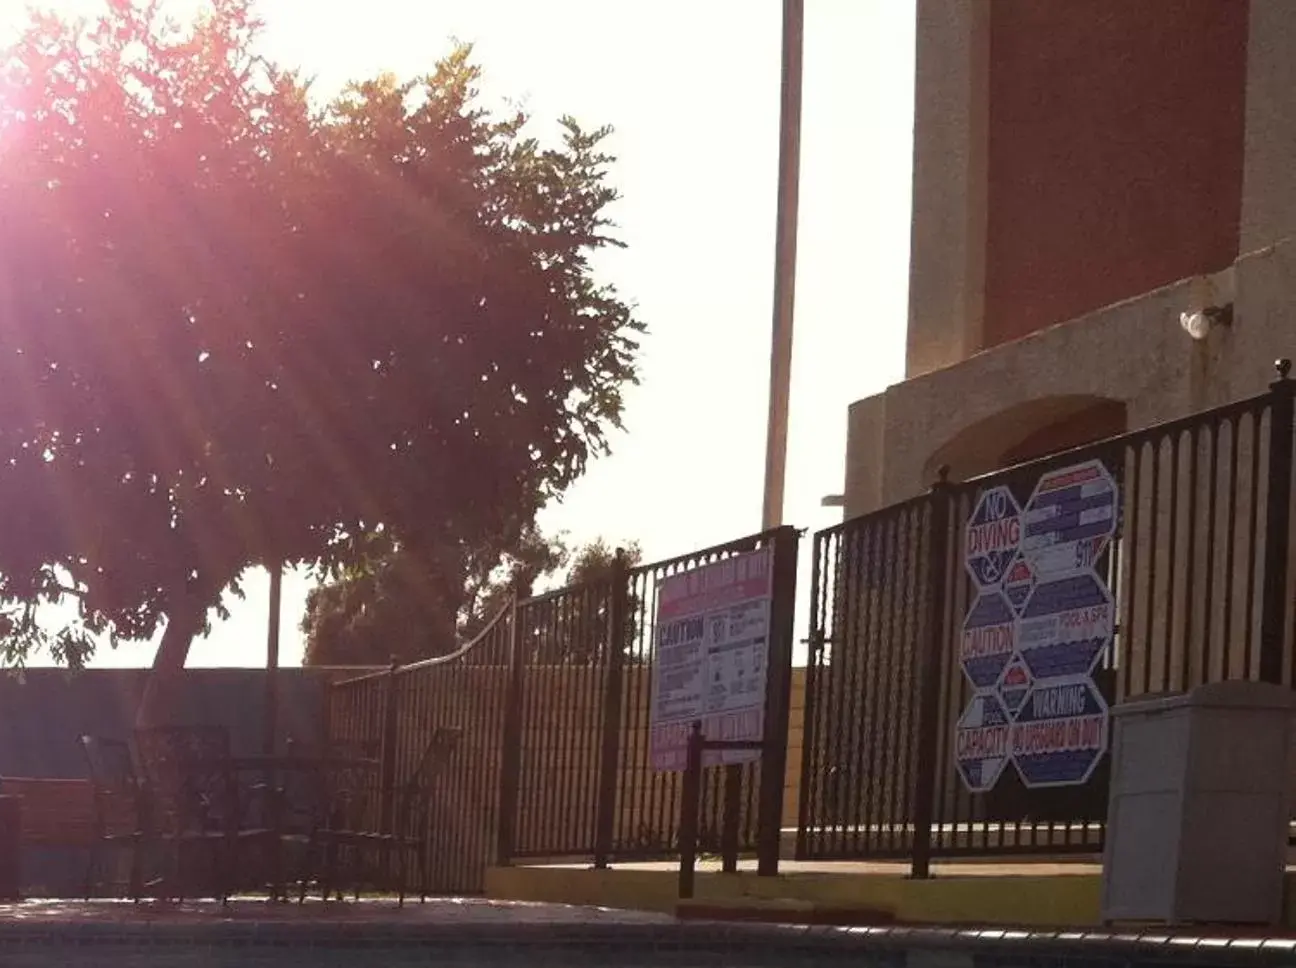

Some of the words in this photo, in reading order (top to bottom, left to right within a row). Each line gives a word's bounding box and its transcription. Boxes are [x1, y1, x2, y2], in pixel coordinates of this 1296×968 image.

[984, 492, 1007, 521] NO
[968, 520, 1020, 553] DIVING
[659, 615, 704, 647] CAUTION
[964, 624, 1013, 656] CAUTION
[1033, 685, 1086, 719] WARNING
[958, 727, 1007, 759] CAPACITY
